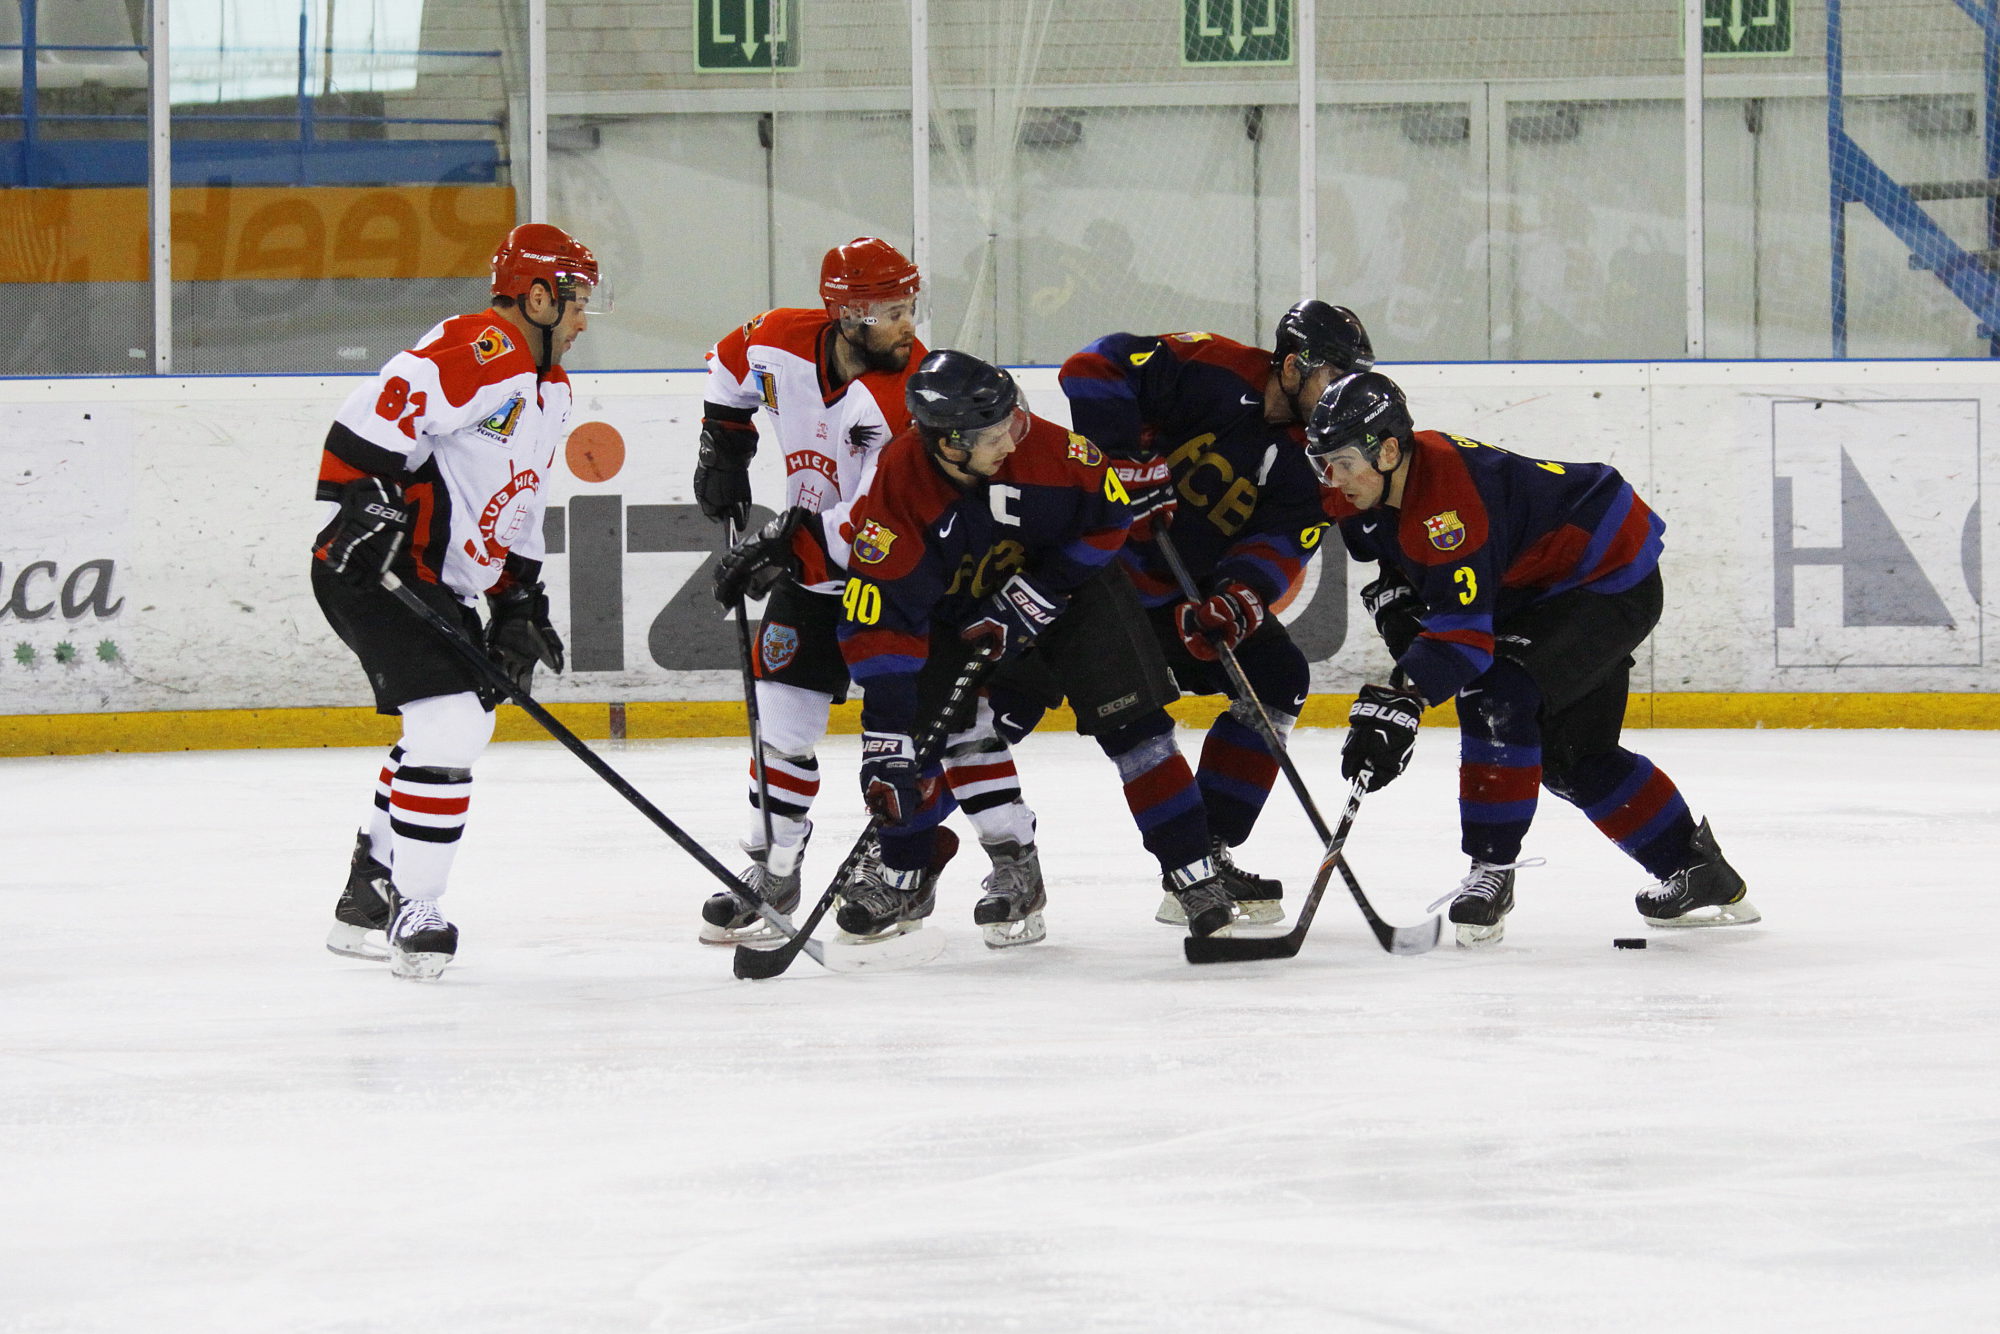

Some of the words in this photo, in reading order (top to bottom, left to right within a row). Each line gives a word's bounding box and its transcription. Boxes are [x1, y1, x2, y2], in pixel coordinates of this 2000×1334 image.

[989, 484, 1021, 527] C
[1167, 432, 1258, 537] FCB
[842, 577, 882, 626] 40
[1453, 566, 1478, 606] 3
[1101, 693, 1136, 714] CCM
